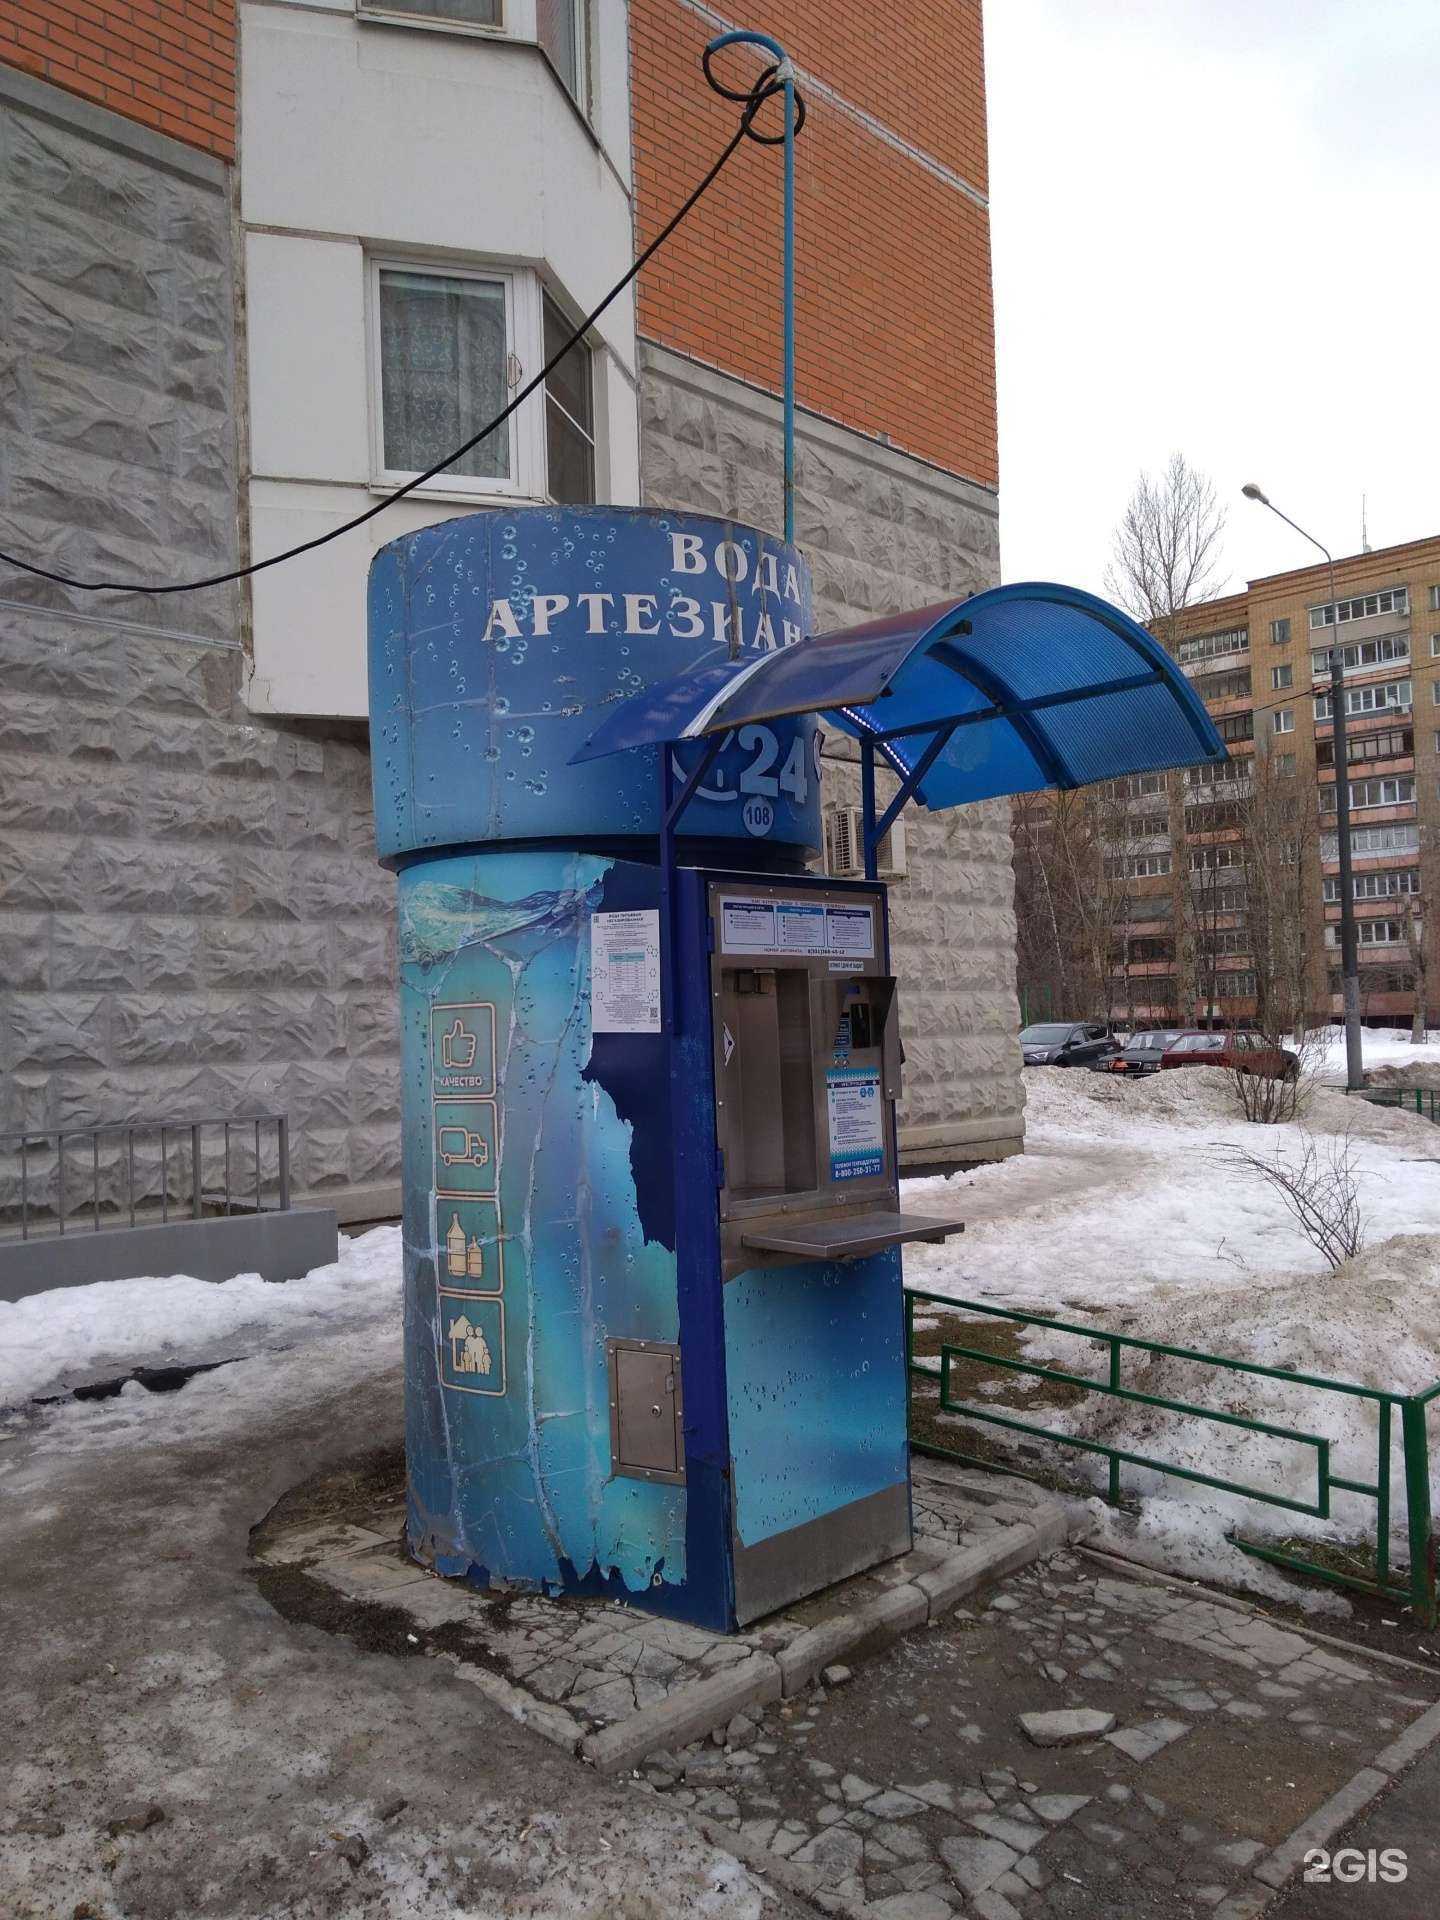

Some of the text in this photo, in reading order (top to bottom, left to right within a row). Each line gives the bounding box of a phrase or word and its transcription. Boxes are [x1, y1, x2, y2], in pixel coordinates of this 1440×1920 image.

[670, 531, 801, 606] ВОДА
[738, 723, 808, 804] 24
[747, 806, 770, 826] 108
[440, 1076, 482, 1088] КАЧЕСТВО
